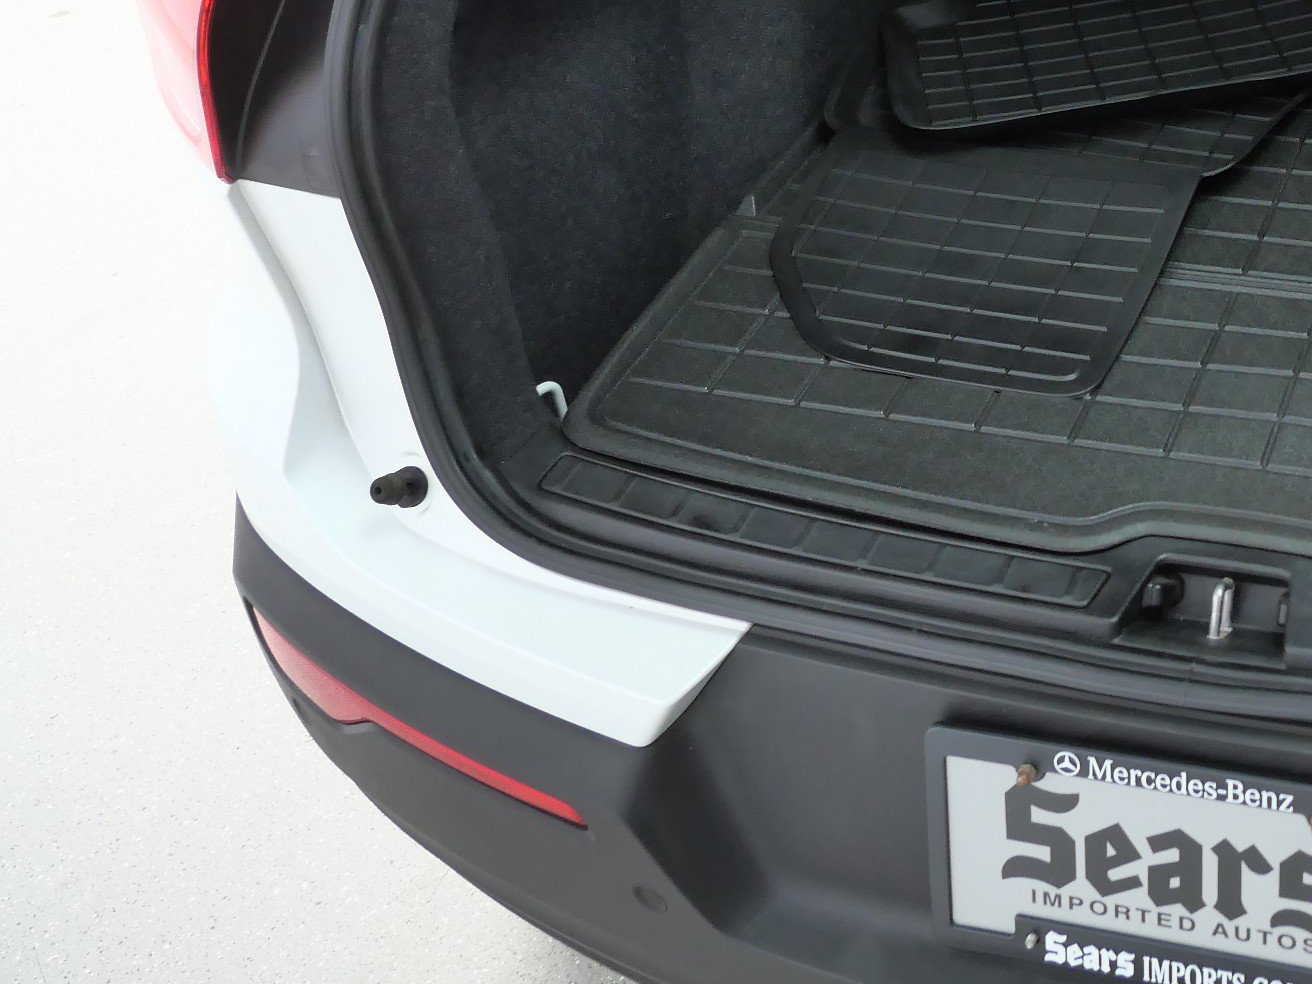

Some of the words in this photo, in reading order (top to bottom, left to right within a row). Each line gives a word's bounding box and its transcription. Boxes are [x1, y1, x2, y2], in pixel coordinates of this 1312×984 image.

[1086, 756, 1295, 813] Mercedes-Benz
[1031, 889, 1197, 933] IMPORTED
[1044, 930, 1136, 979] Sears
